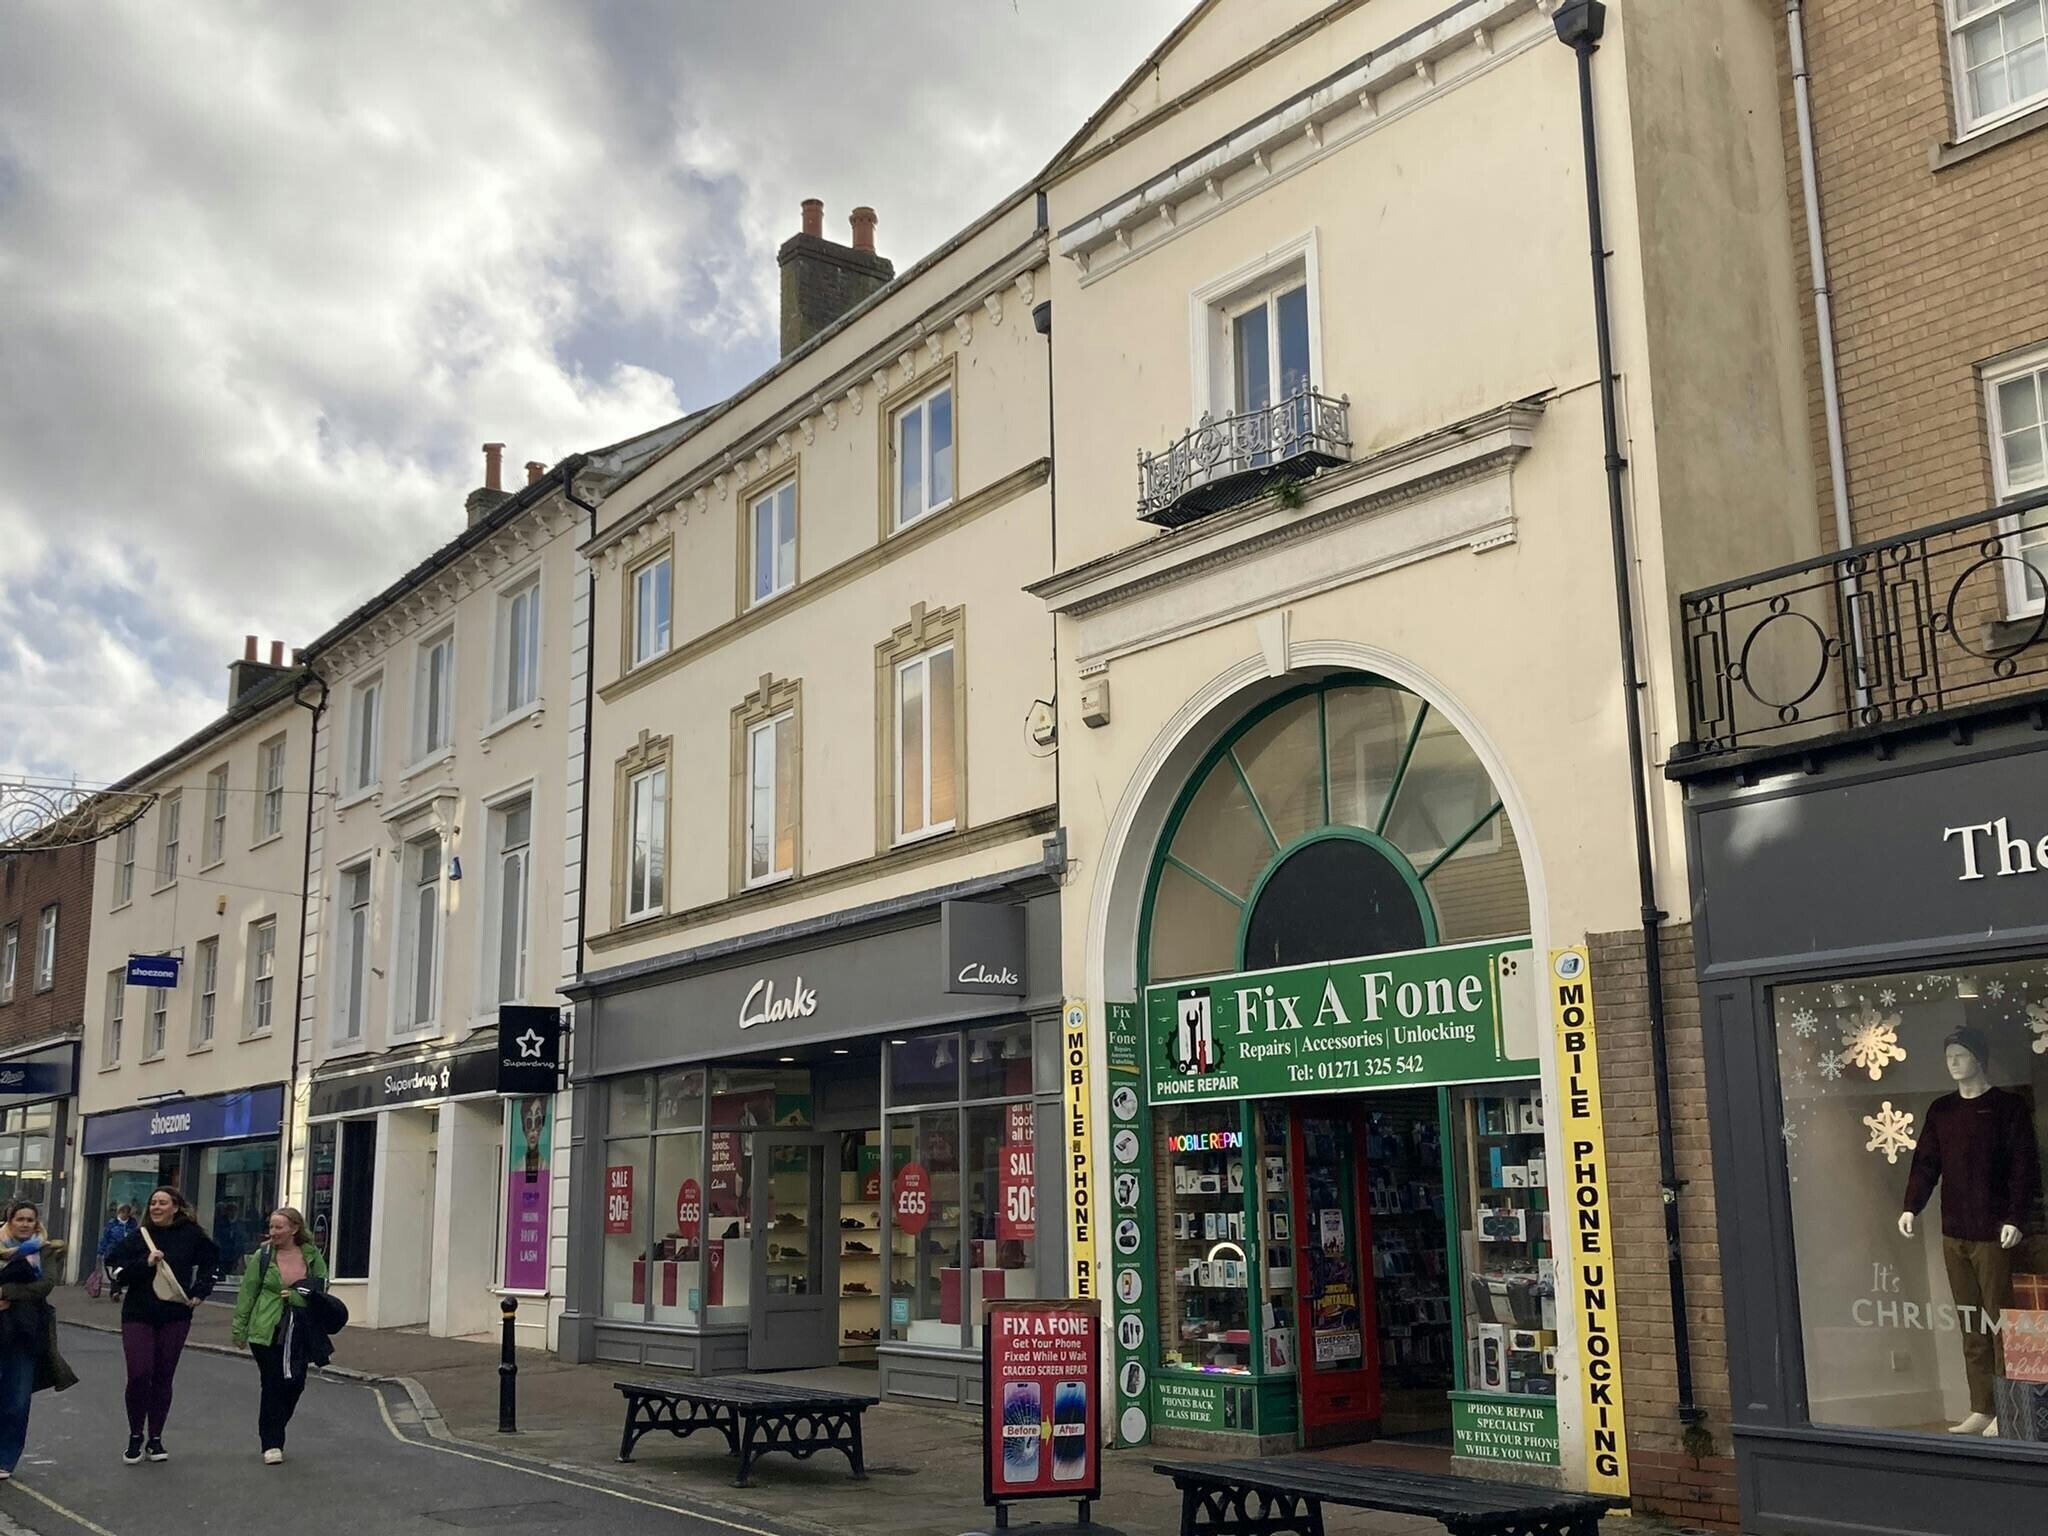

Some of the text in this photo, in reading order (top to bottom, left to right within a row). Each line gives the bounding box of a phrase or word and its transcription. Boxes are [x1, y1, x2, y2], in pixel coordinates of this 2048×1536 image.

[131, 968, 174, 979] shoezone
[957, 963, 1018, 985] Clarks
[739, 976, 817, 1029] Clarks
[1234, 970, 1483, 1035] Fix A Fone
[1113, 1006, 1131, 1018] Fix
[1117, 1019, 1127, 1031] A
[1109, 1032, 1137, 1044] Fone
[1239, 1022, 1476, 1060] Repairs Accessories Unlocking
[503, 1058, 555, 1070] Superdrug
[1287, 1054, 1424, 1082] Tel: 01271 325 542
[385, 1075, 437, 1096] Superdrug
[1157, 1076, 1239, 1095] PHONE REPAIR
[151, 1112, 191, 1136] shoezone
[1012, 1114, 1033, 1127] boot
[1012, 1131, 1023, 1140] all
[1169, 1134, 1209, 1152] MOBILE
[1010, 1153, 1034, 1176] SAL
[1069, 1033, 1090, 1298] MOBILE PHONE RE
[611, 1171, 628, 1188] SALE
[899, 1191, 926, 1214] £65
[680, 1203, 700, 1222] £65
[1559, 984, 1619, 1477] MOBILE PHONE UNLOCKING
[1871, 1263, 1900, 1293] It's
[1003, 1318, 1088, 1335] FIX A FONE
[1852, 1299, 2048, 1339] CHRISTMA
[1012, 1338, 1081, 1348] Get Your Phone
[1005, 1351, 1087, 1361] Fixed While U Wait
[1003, 1365, 1087, 1376] CRACKED SCREEN REPAIR
[1160, 1384, 1216, 1398] WE REPAIR ALL
[1162, 1397, 1213, 1410] PHONES BACK
[1165, 1409, 1211, 1422] GLASS HERE
[1506, 1406, 1544, 1420] REPAIR
[1007, 1426, 1037, 1436] Before
[1059, 1425, 1079, 1434] After
[1477, 1418, 1535, 1433] SPECIALIST
[1456, 1430, 1559, 1449] WE FIX YOUR PHONE
[1465, 1444, 1552, 1462] WHILE YOU WAIT
